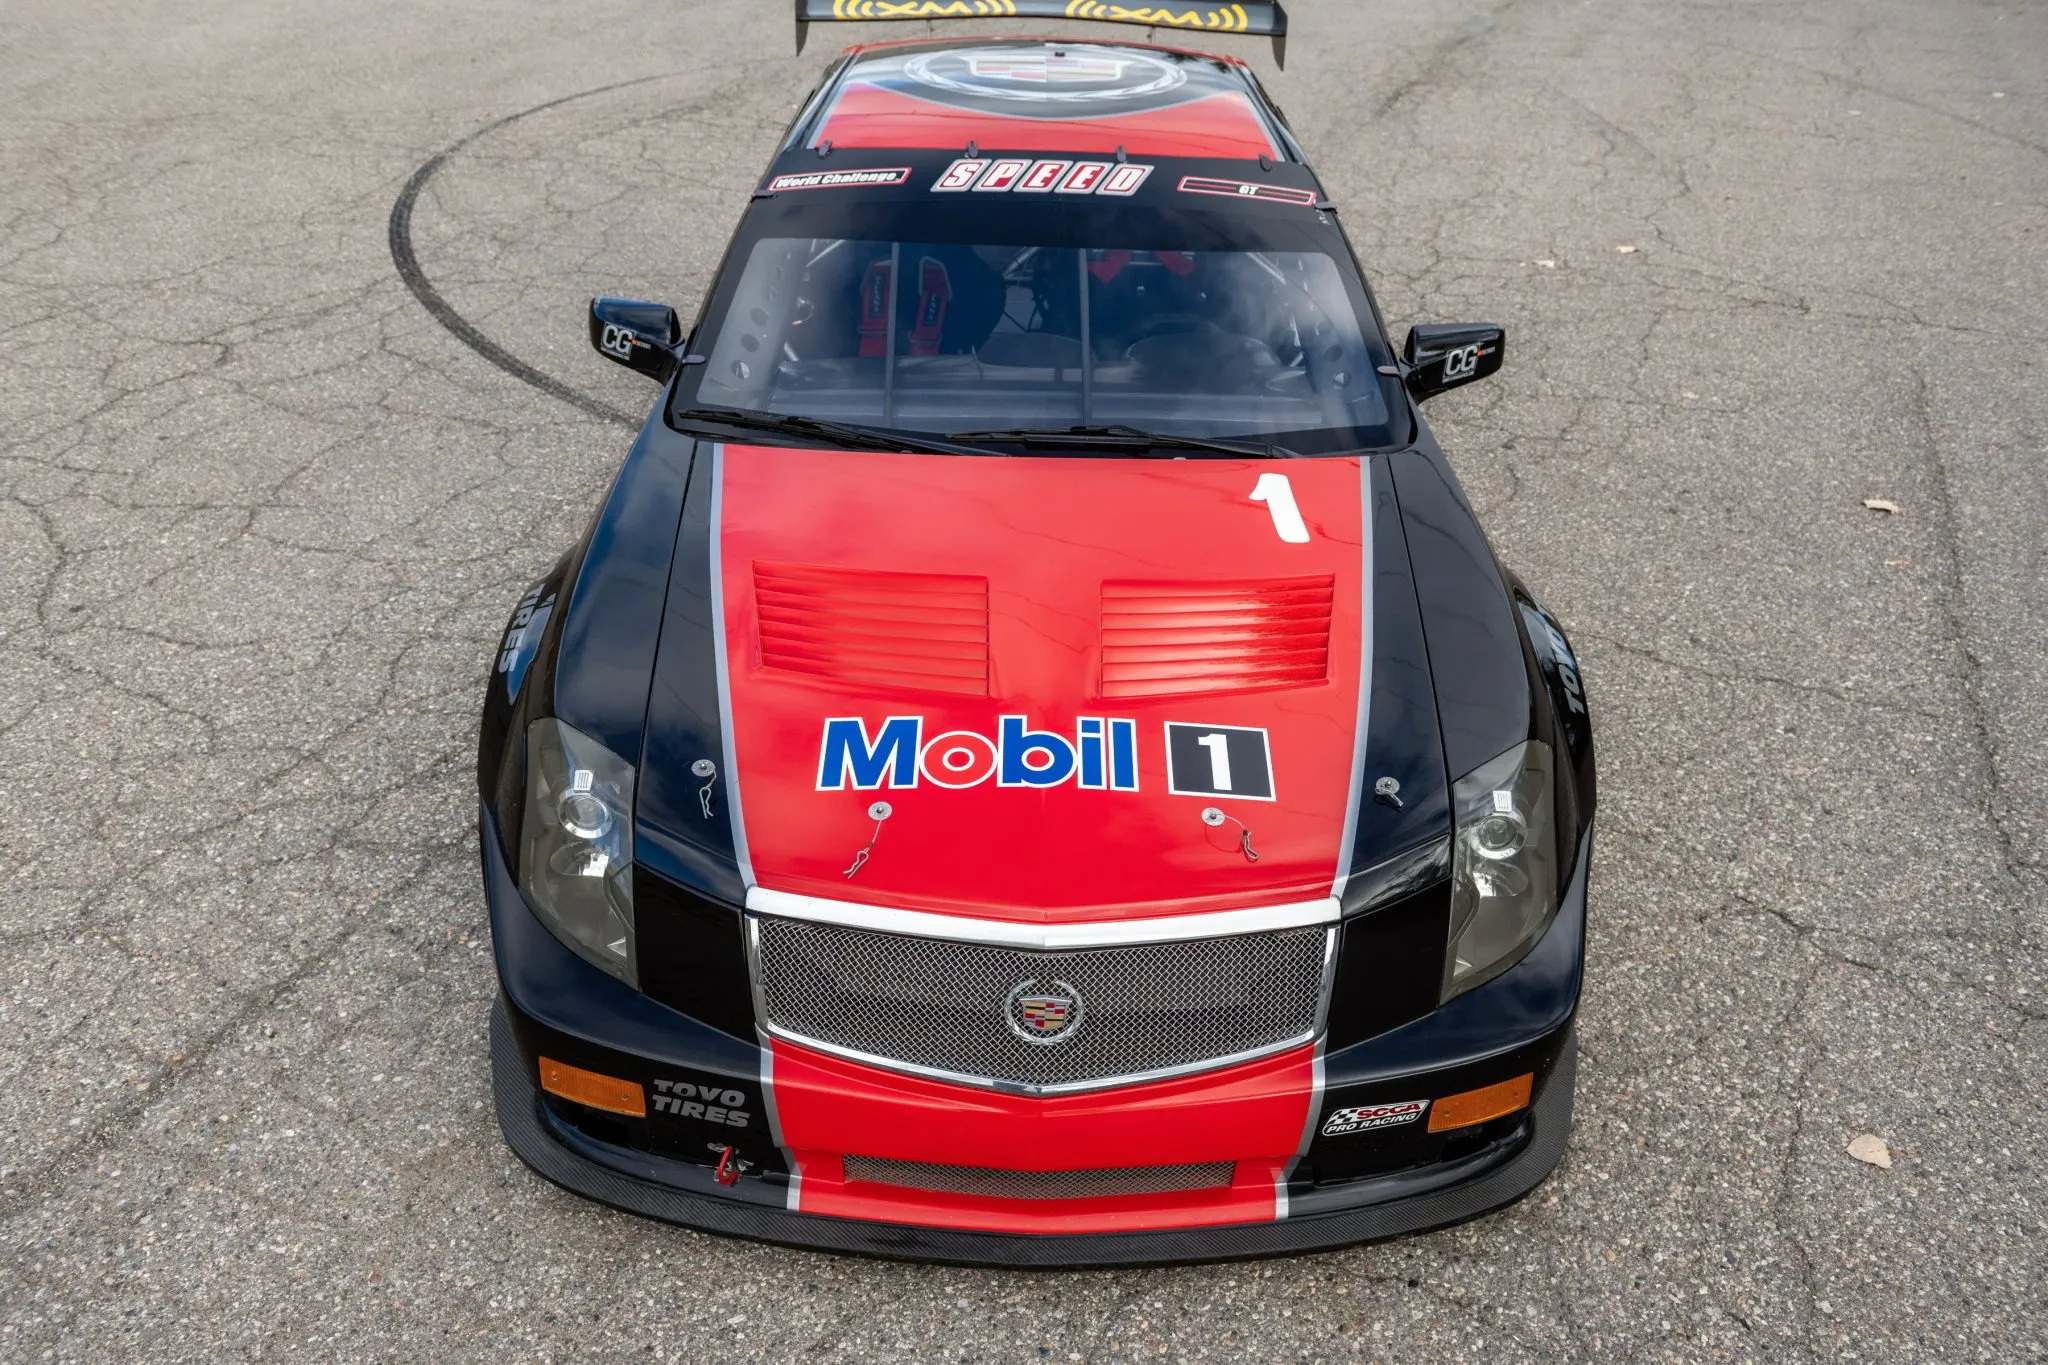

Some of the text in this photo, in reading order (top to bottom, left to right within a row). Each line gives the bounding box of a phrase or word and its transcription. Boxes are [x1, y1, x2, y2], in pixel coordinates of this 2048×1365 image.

[775, 172, 897, 188] World Challenge
[938, 161, 1148, 194] SPEED
[1239, 185, 1260, 195] GT
[603, 325, 633, 354] CG
[1446, 345, 1478, 376] CG
[1248, 472, 1311, 544] 1
[499, 583, 547, 673] TIRES
[815, 715, 1233, 793] Mobil 1
[652, 1094, 751, 1128] TIRES
[1326, 1112, 1417, 1134] PRO RACING
[1356, 1103, 1422, 1119] SCCA
